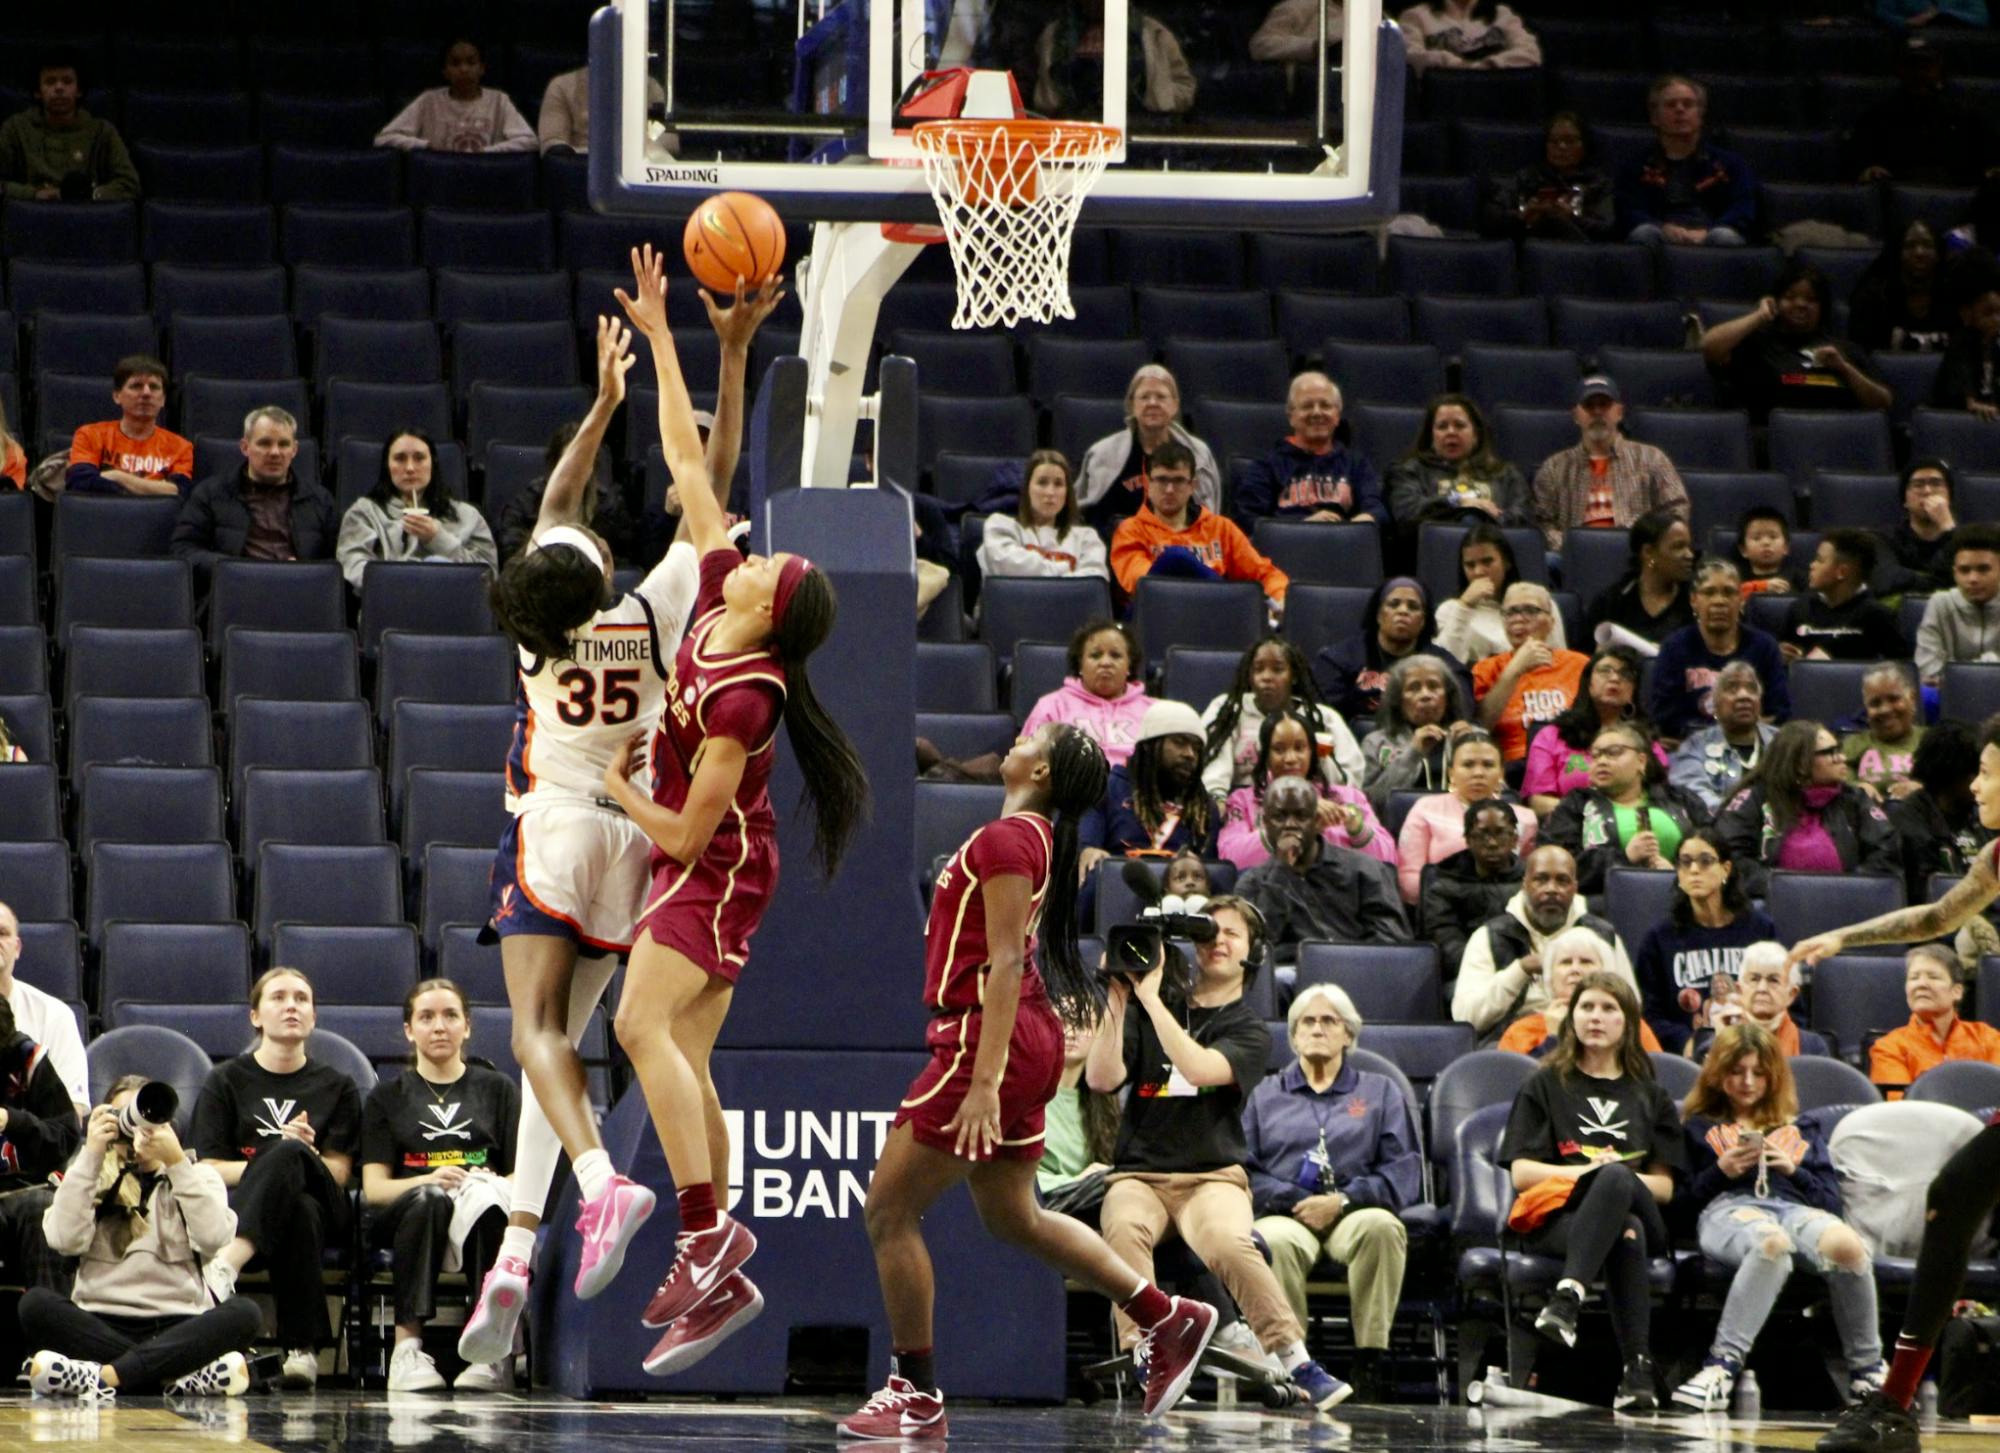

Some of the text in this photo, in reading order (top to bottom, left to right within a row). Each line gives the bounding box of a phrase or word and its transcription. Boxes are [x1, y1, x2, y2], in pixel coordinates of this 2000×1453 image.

[646, 167, 718, 183] SPALDING
[572, 639, 650, 661] TTIMORE
[556, 667, 641, 727] 35
[754, 1110, 898, 1160] UNIT
[753, 1169, 877, 1218] BAN
